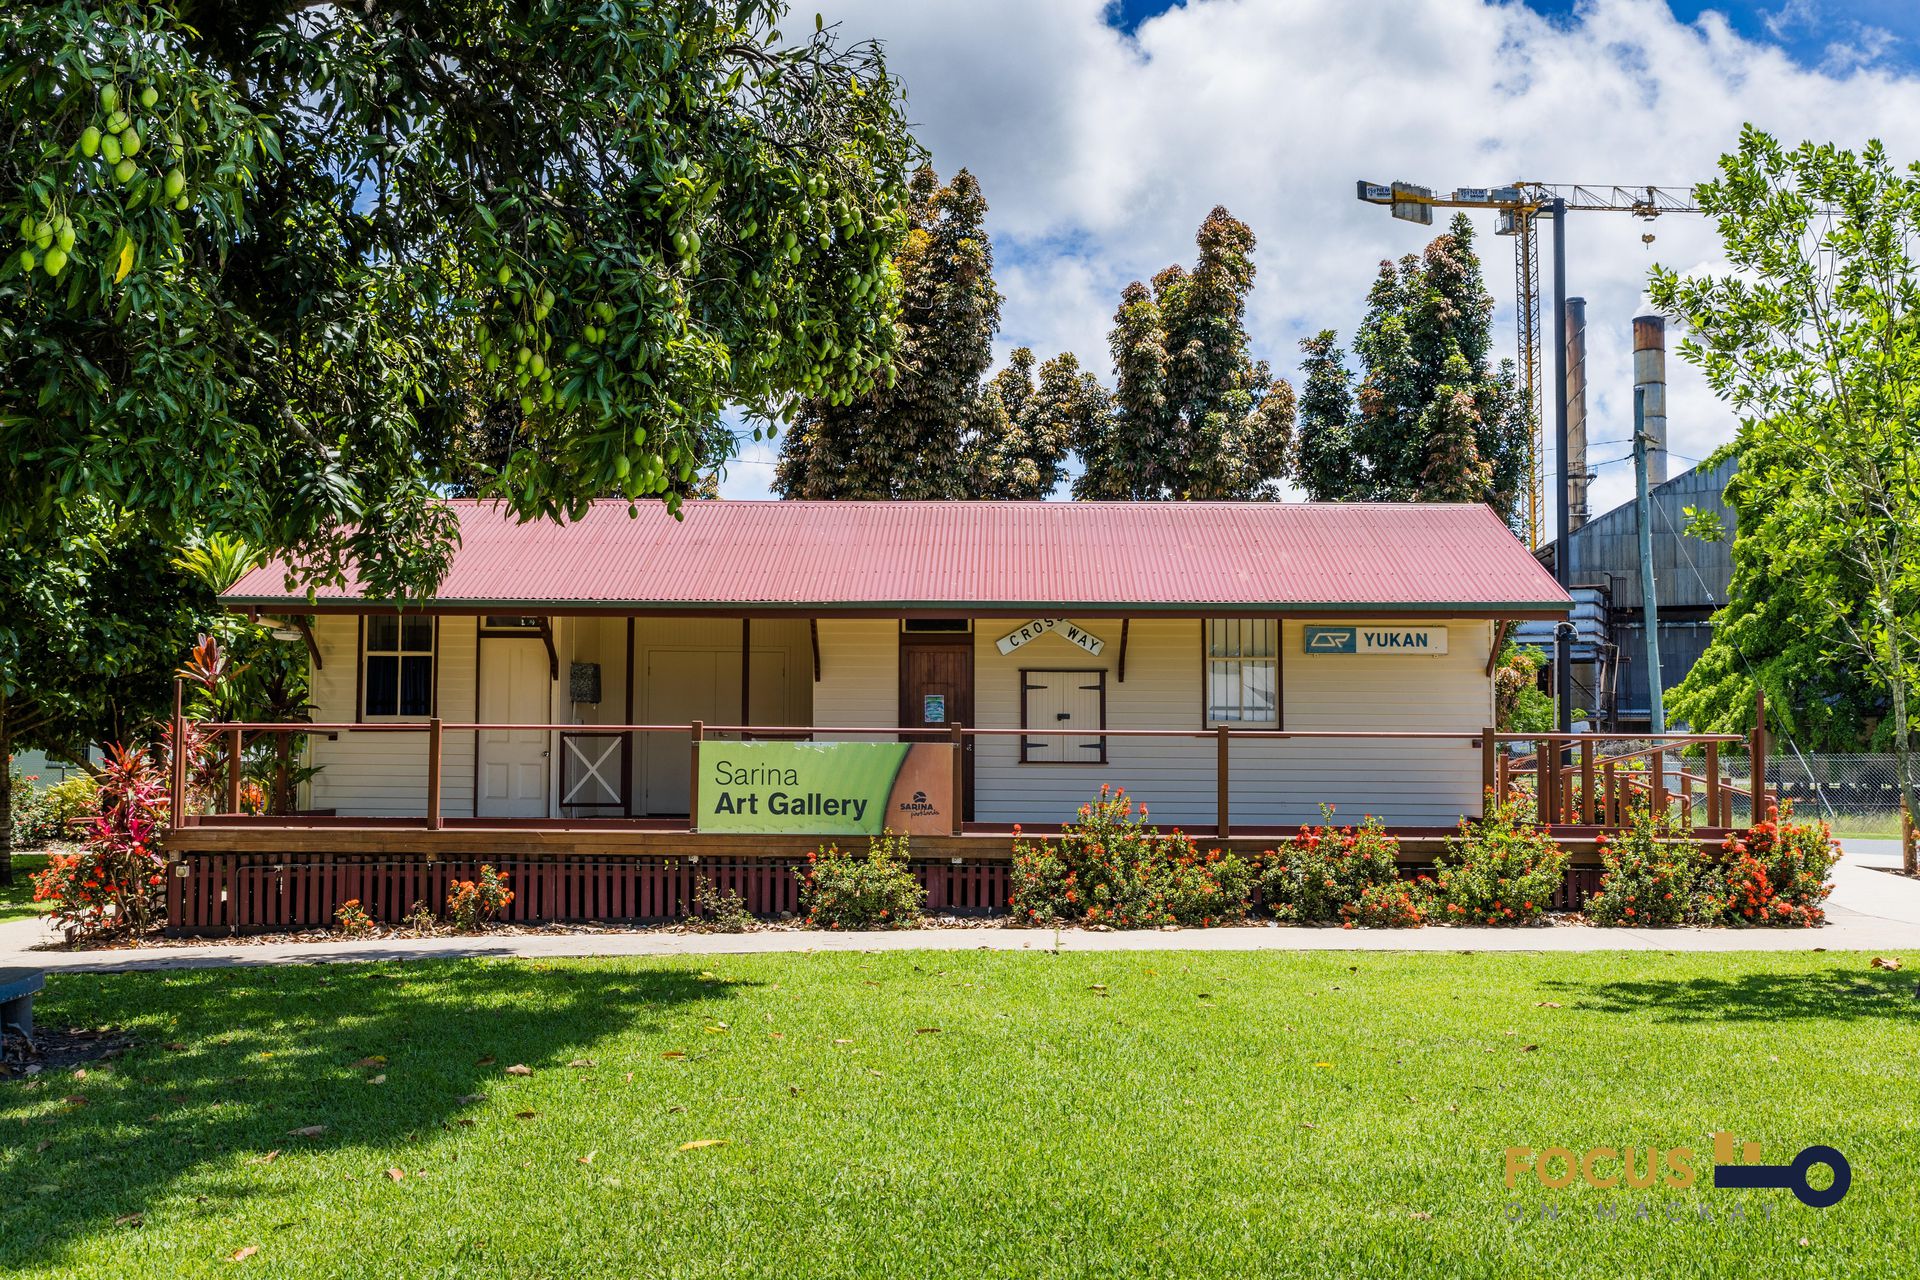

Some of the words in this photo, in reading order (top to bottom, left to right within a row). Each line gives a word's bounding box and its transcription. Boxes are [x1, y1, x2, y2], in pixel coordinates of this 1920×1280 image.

[1009, 618, 1064, 647] CROS
[1067, 626, 1099, 651] WAY
[1363, 632, 1428, 647] YUKAN
[714, 760, 799, 786] Sarina
[714, 792, 758, 815] Art
[767, 792, 868, 821] Gallery
